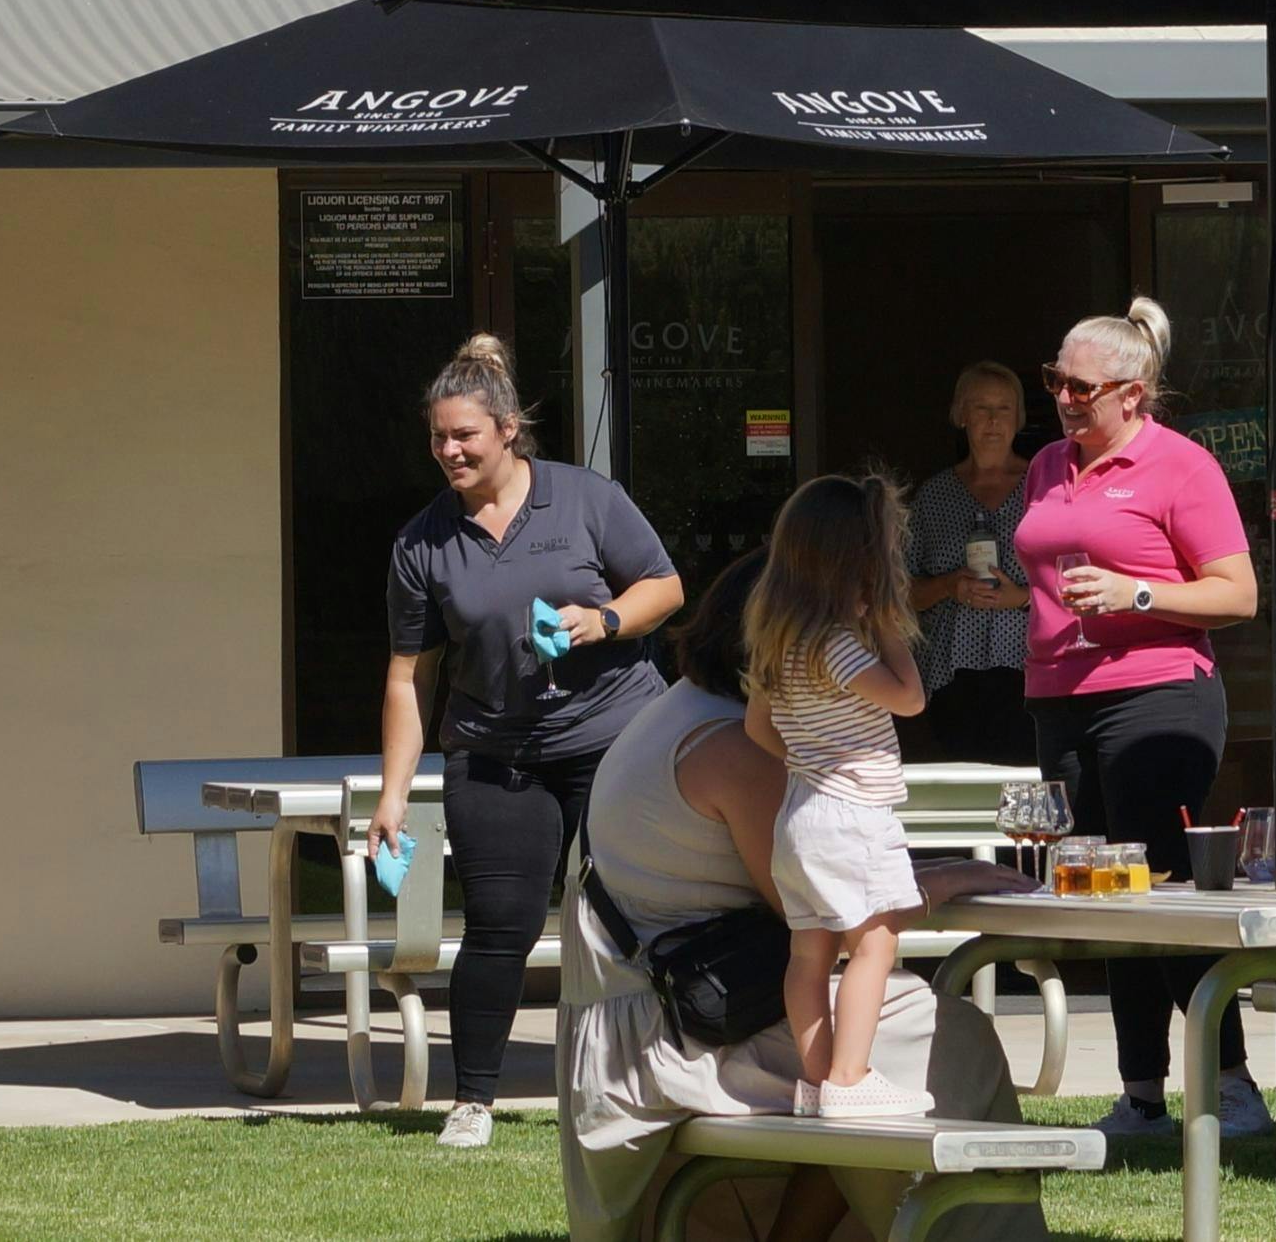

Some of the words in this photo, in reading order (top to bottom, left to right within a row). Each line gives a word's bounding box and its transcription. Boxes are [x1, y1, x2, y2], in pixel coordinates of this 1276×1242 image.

[297, 85, 529, 111] ANGOVE
[772, 90, 956, 114] ANGOVE
[271, 122, 351, 133] FAMILY
[355, 119, 491, 133] WINEMAKERS
[815, 127, 874, 140] FAMILY
[877, 128, 988, 142] WINEMAKERS
[308, 195, 346, 206] LIQUOR
[347, 195, 400, 205] LICENSING
[402, 195, 421, 205] ACT
[424, 195, 445, 205] 1997
[319, 214, 347, 222] LIQUOR
[750, 413, 787, 422] WARNING
